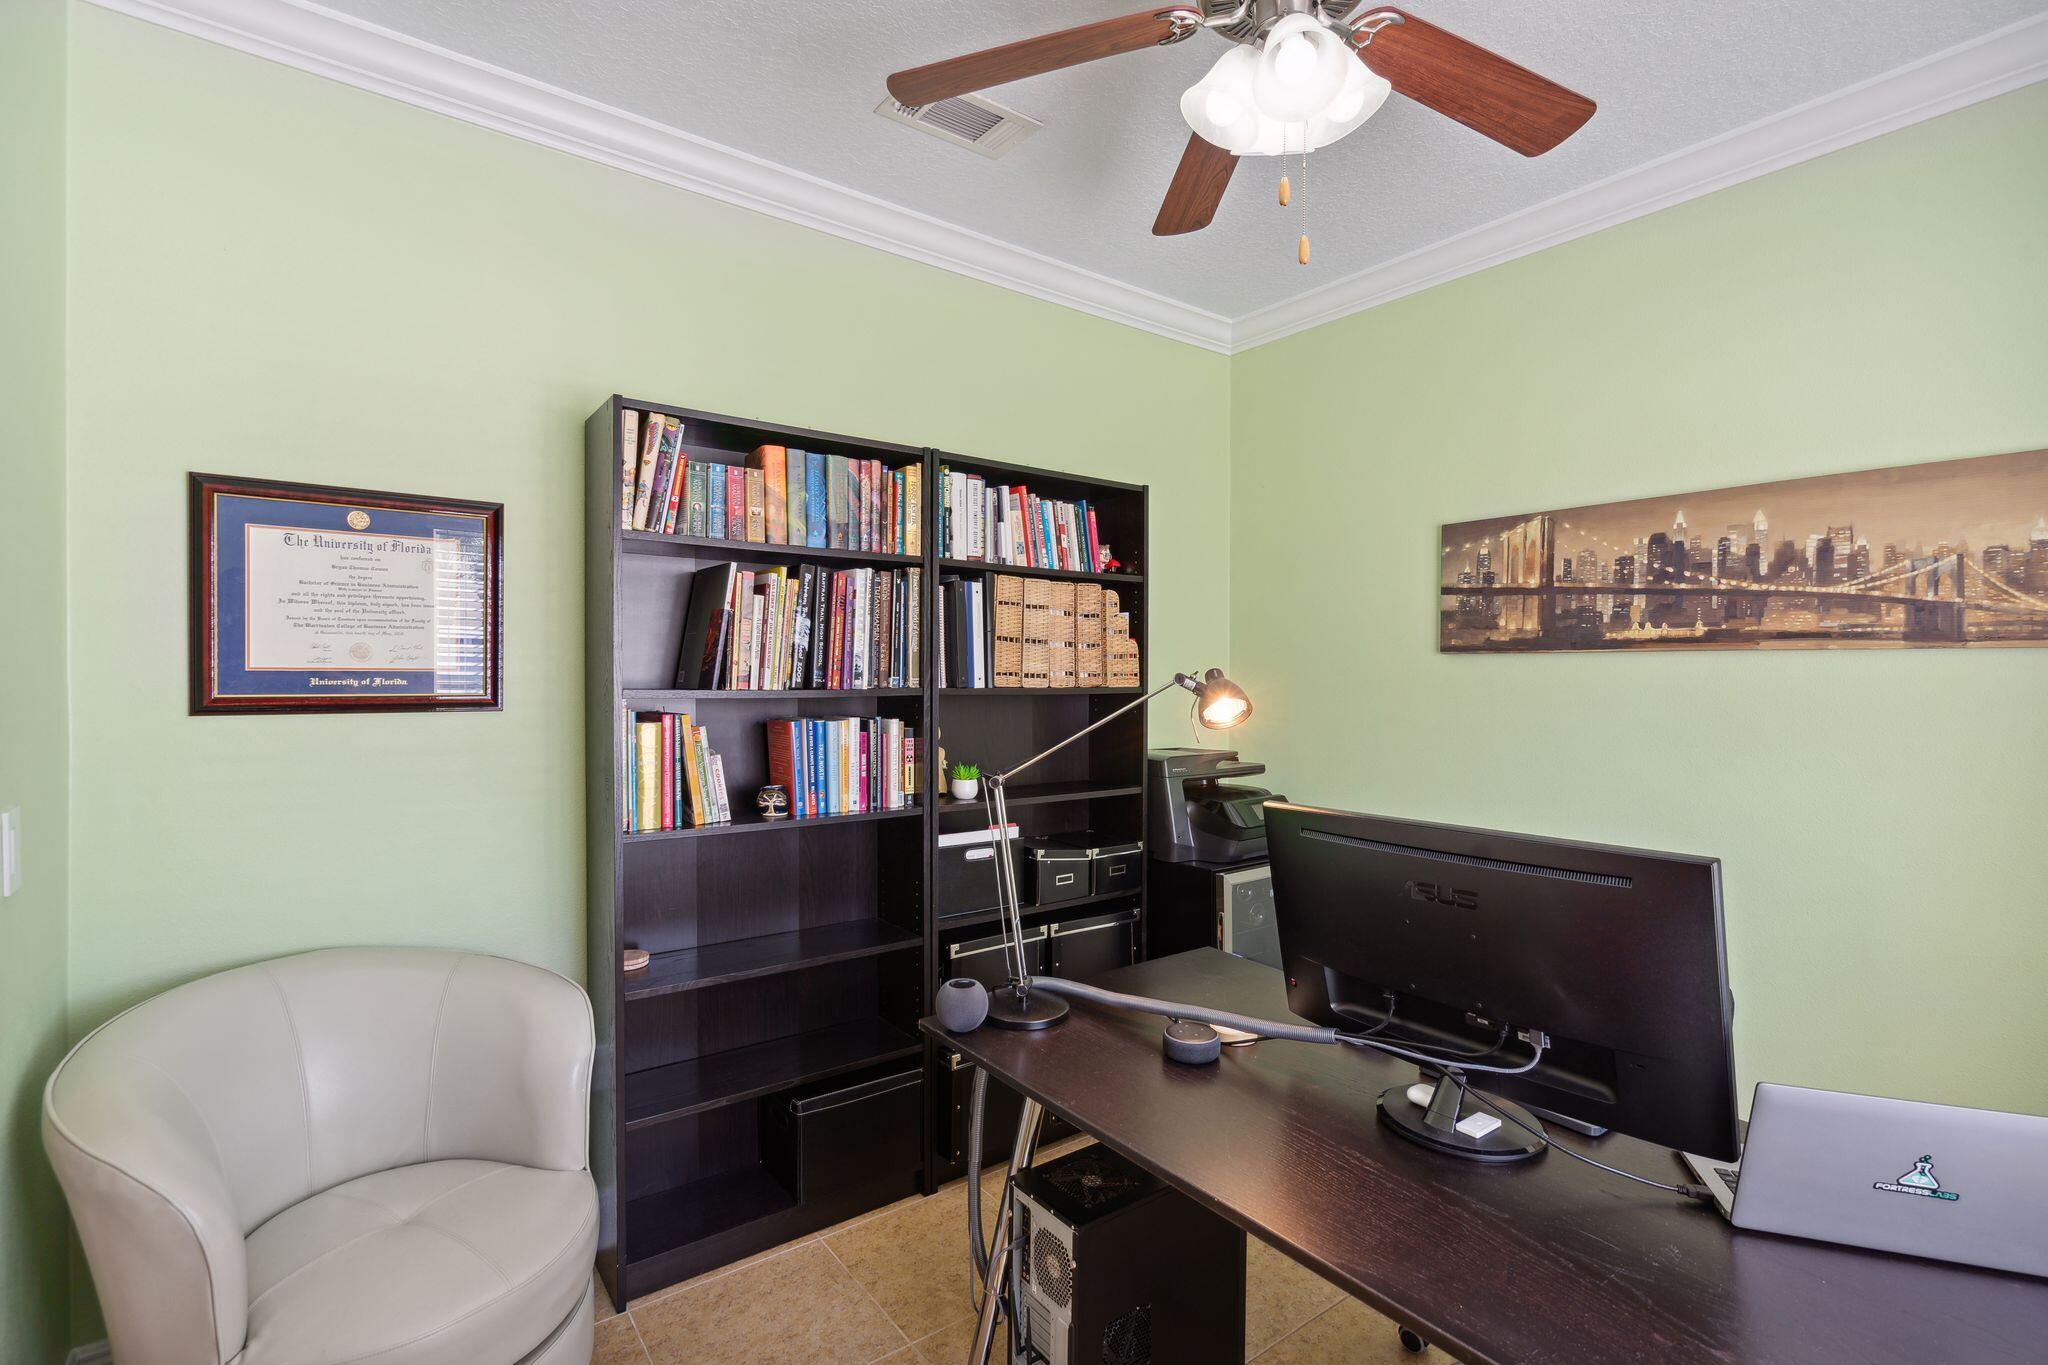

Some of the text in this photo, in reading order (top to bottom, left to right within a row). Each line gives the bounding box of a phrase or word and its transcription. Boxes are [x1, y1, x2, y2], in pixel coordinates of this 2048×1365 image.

[283, 532, 432, 554] The University of Florida
[802, 572, 812, 605] Bartram
[912, 575, 920, 606] Fascinating
[873, 585, 881, 641] TUTANKHAMUN
[912, 606, 920, 623] World
[309, 677, 359, 688] University
[360, 678, 370, 686] of
[715, 768, 725, 801] cookies
[1405, 881, 1479, 911] ASUS
